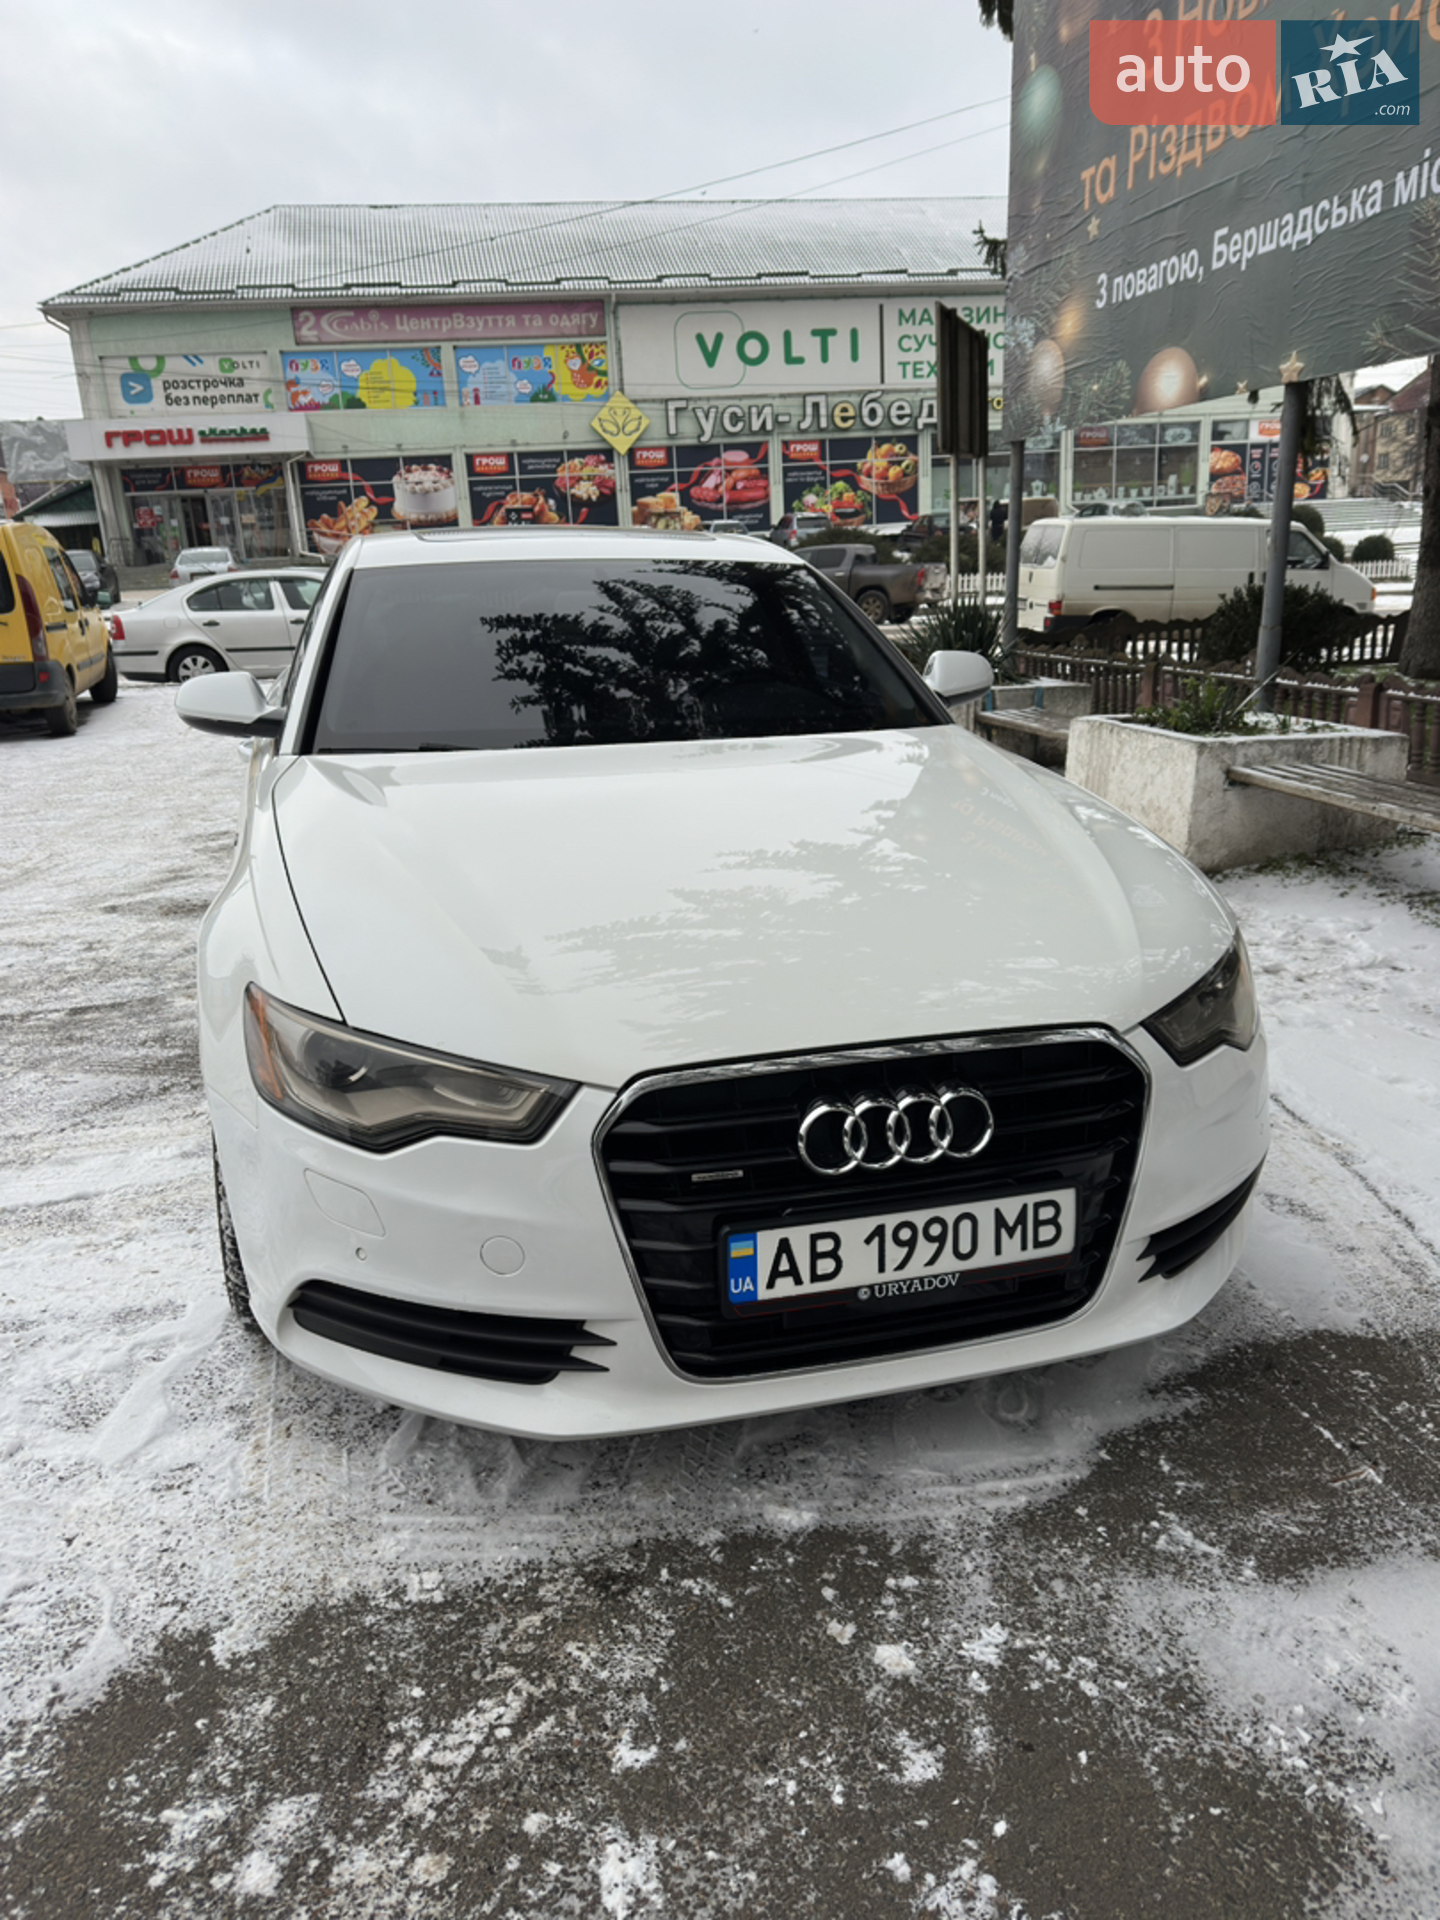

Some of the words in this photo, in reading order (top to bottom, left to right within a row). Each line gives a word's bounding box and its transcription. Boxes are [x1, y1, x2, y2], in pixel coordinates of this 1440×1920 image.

[1081, 154, 1117, 211] та
[1096, 273, 1108, 309] З
[1112, 249, 1205, 303] повагою,
[1212, 178, 1382, 271] Бершадська
[522, 314, 543, 327] та
[549, 312, 598, 328] одягу
[898, 306, 1006, 326] МАЗИН
[695, 327, 859, 368] VOLTI
[222, 360, 260, 370] VOLTI
[163, 377, 244, 391] розстрочка
[165, 394, 190, 406] без
[192, 393, 259, 409] переплат
[105, 427, 194, 448] ГРОШ
[476, 456, 506, 466] ГРОШ
[636, 449, 666, 459] ГРОШ
[187, 468, 219, 477] ГРОШ
[308, 464, 339, 473] ГРОШ
[730, 1278, 755, 1295] UA
[766, 1231, 844, 1290] AB
[863, 1212, 979, 1275] 1990
[994, 1199, 1063, 1257] MB
[874, 1273, 961, 1299] URYADOV
